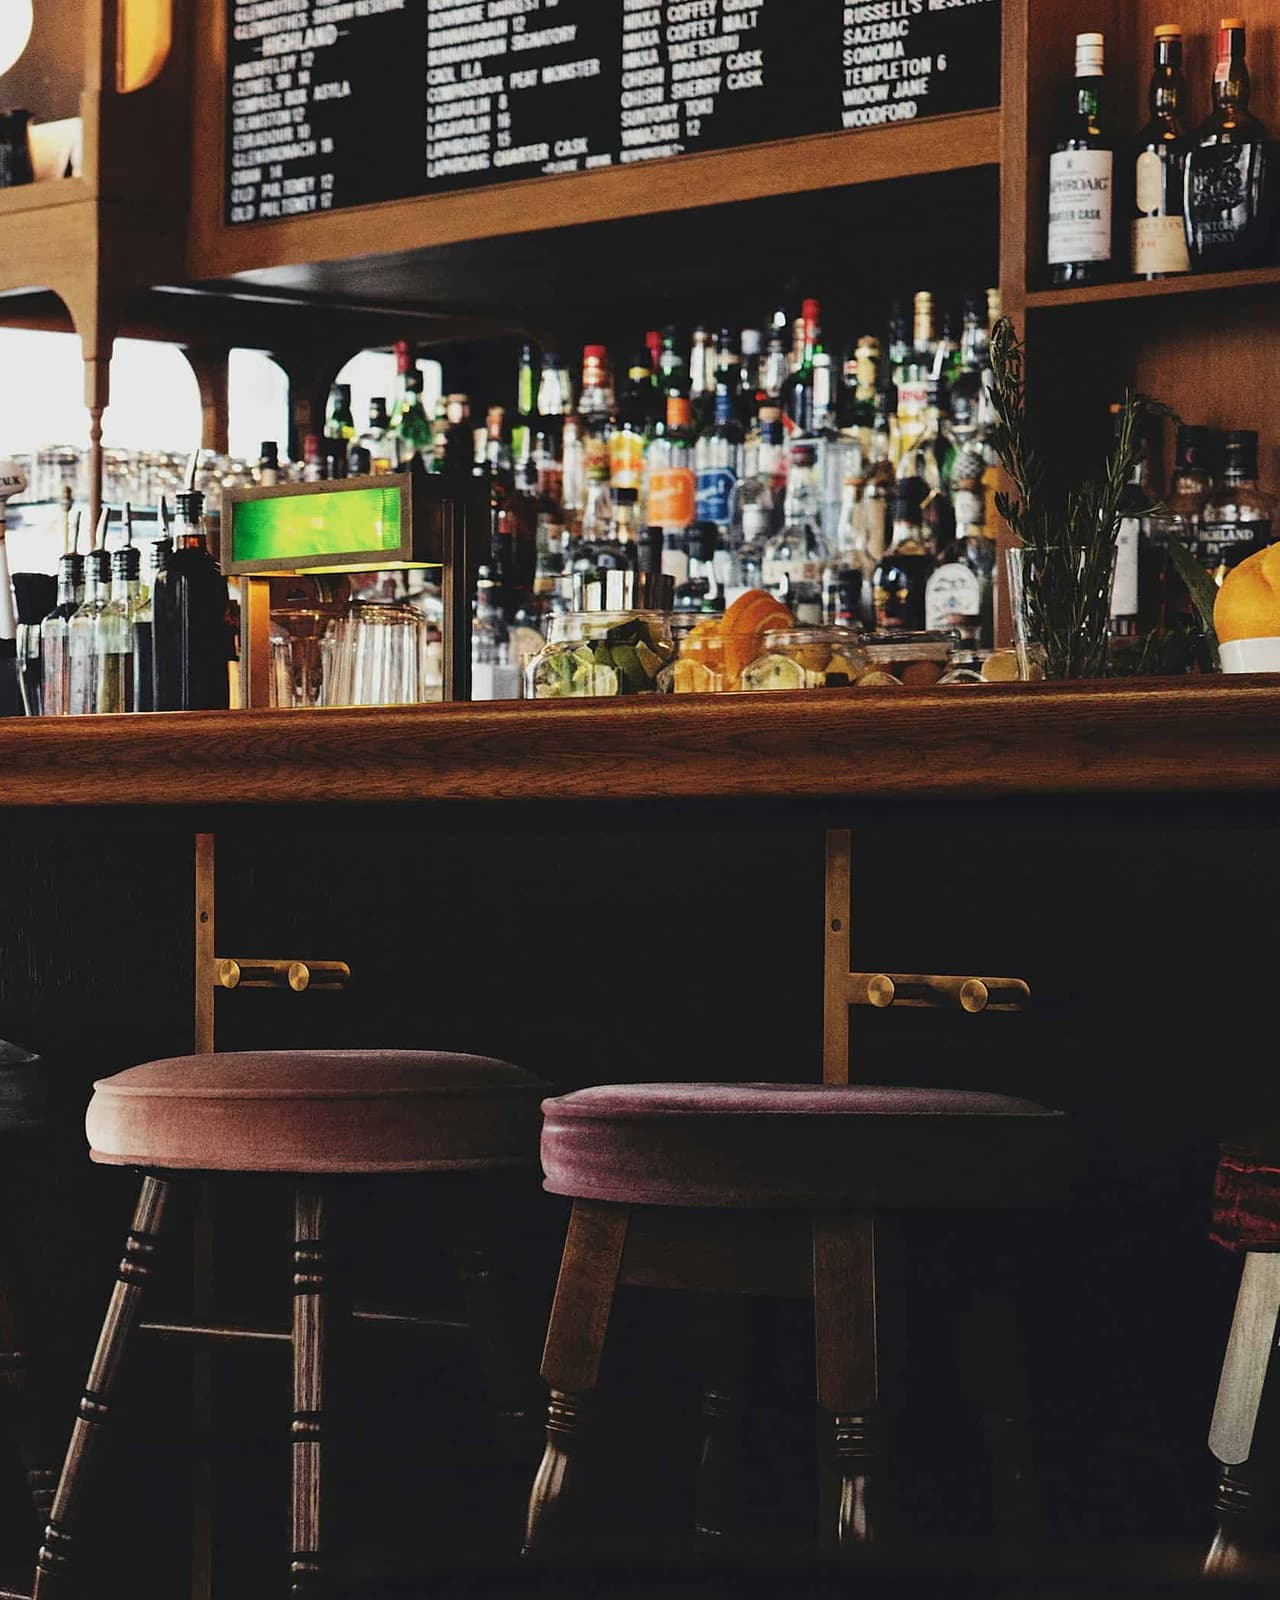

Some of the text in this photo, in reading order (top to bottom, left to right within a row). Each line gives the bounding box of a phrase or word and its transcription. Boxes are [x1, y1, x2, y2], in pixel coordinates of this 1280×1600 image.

[666, 0, 718, 23] COFFEY
[666, 18, 717, 43] COFFEY
[722, 10, 758, 33] MALT
[842, 18, 910, 46] SAZERAC
[726, 49, 763, 71] CASK
[842, 40, 905, 66] SONOMA
[727, 69, 763, 90] CASK
[844, 54, 947, 87] TEMPLETON 6
[842, 76, 929, 106] WIDOW JANE
[842, 100, 918, 129] WOODFORD
[554, 137, 589, 158] CASK
